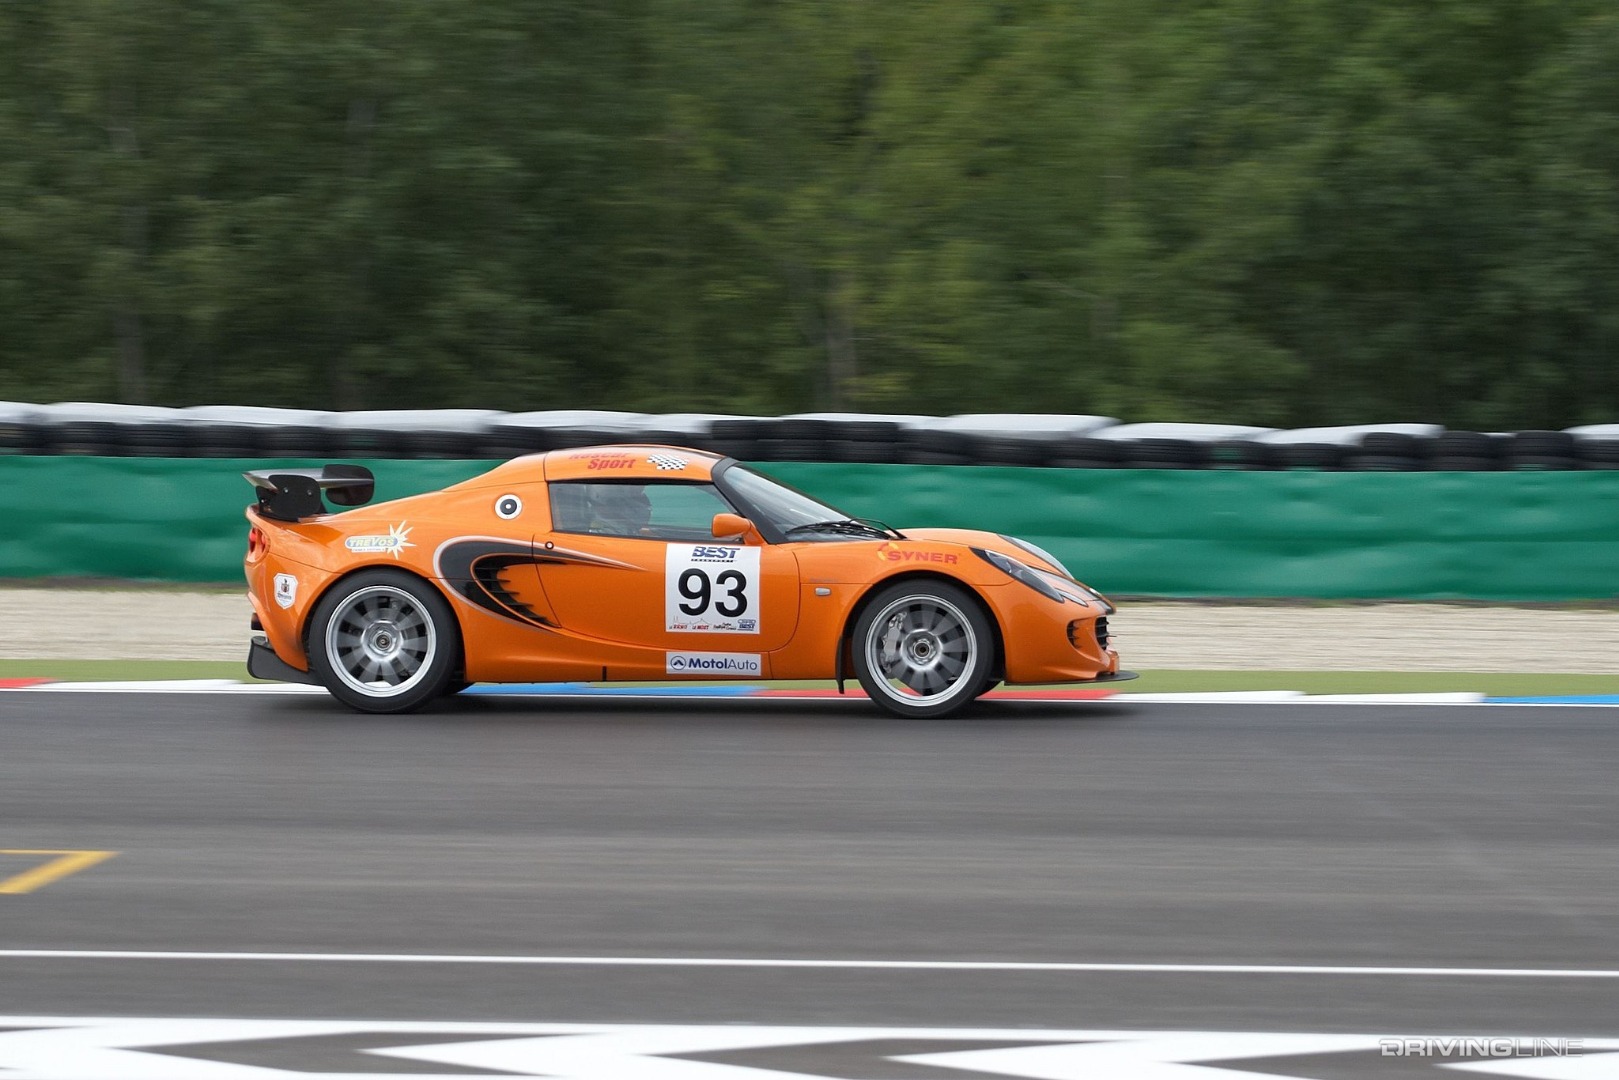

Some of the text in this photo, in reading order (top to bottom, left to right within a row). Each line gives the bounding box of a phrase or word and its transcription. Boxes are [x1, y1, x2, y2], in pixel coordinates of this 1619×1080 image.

[587, 458, 636, 470] Sport
[349, 536, 395, 548] TREVOS
[691, 545, 741, 559] BEST
[887, 550, 958, 565] SYNER
[677, 567, 748, 618] 93
[688, 657, 758, 671] MotolAuto
